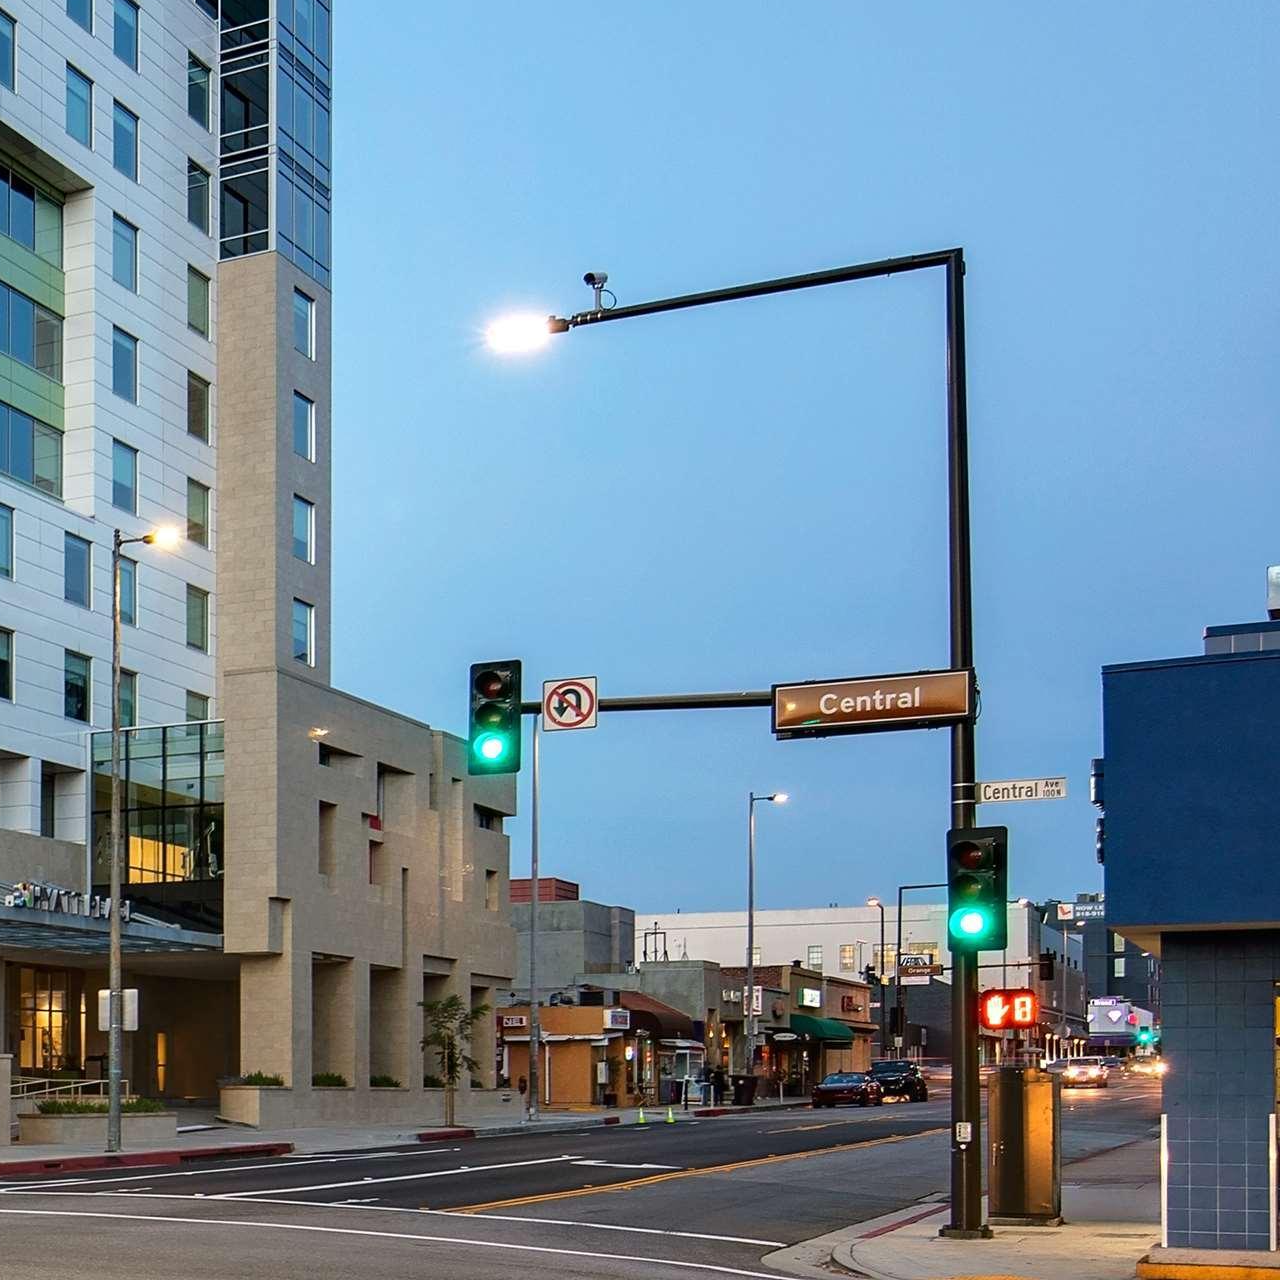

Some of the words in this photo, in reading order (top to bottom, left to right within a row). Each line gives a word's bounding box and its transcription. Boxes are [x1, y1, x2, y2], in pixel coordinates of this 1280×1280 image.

[820, 686, 920, 715] Central
[983, 782, 1038, 800] Central
[1044, 780, 1060, 788] Ave
